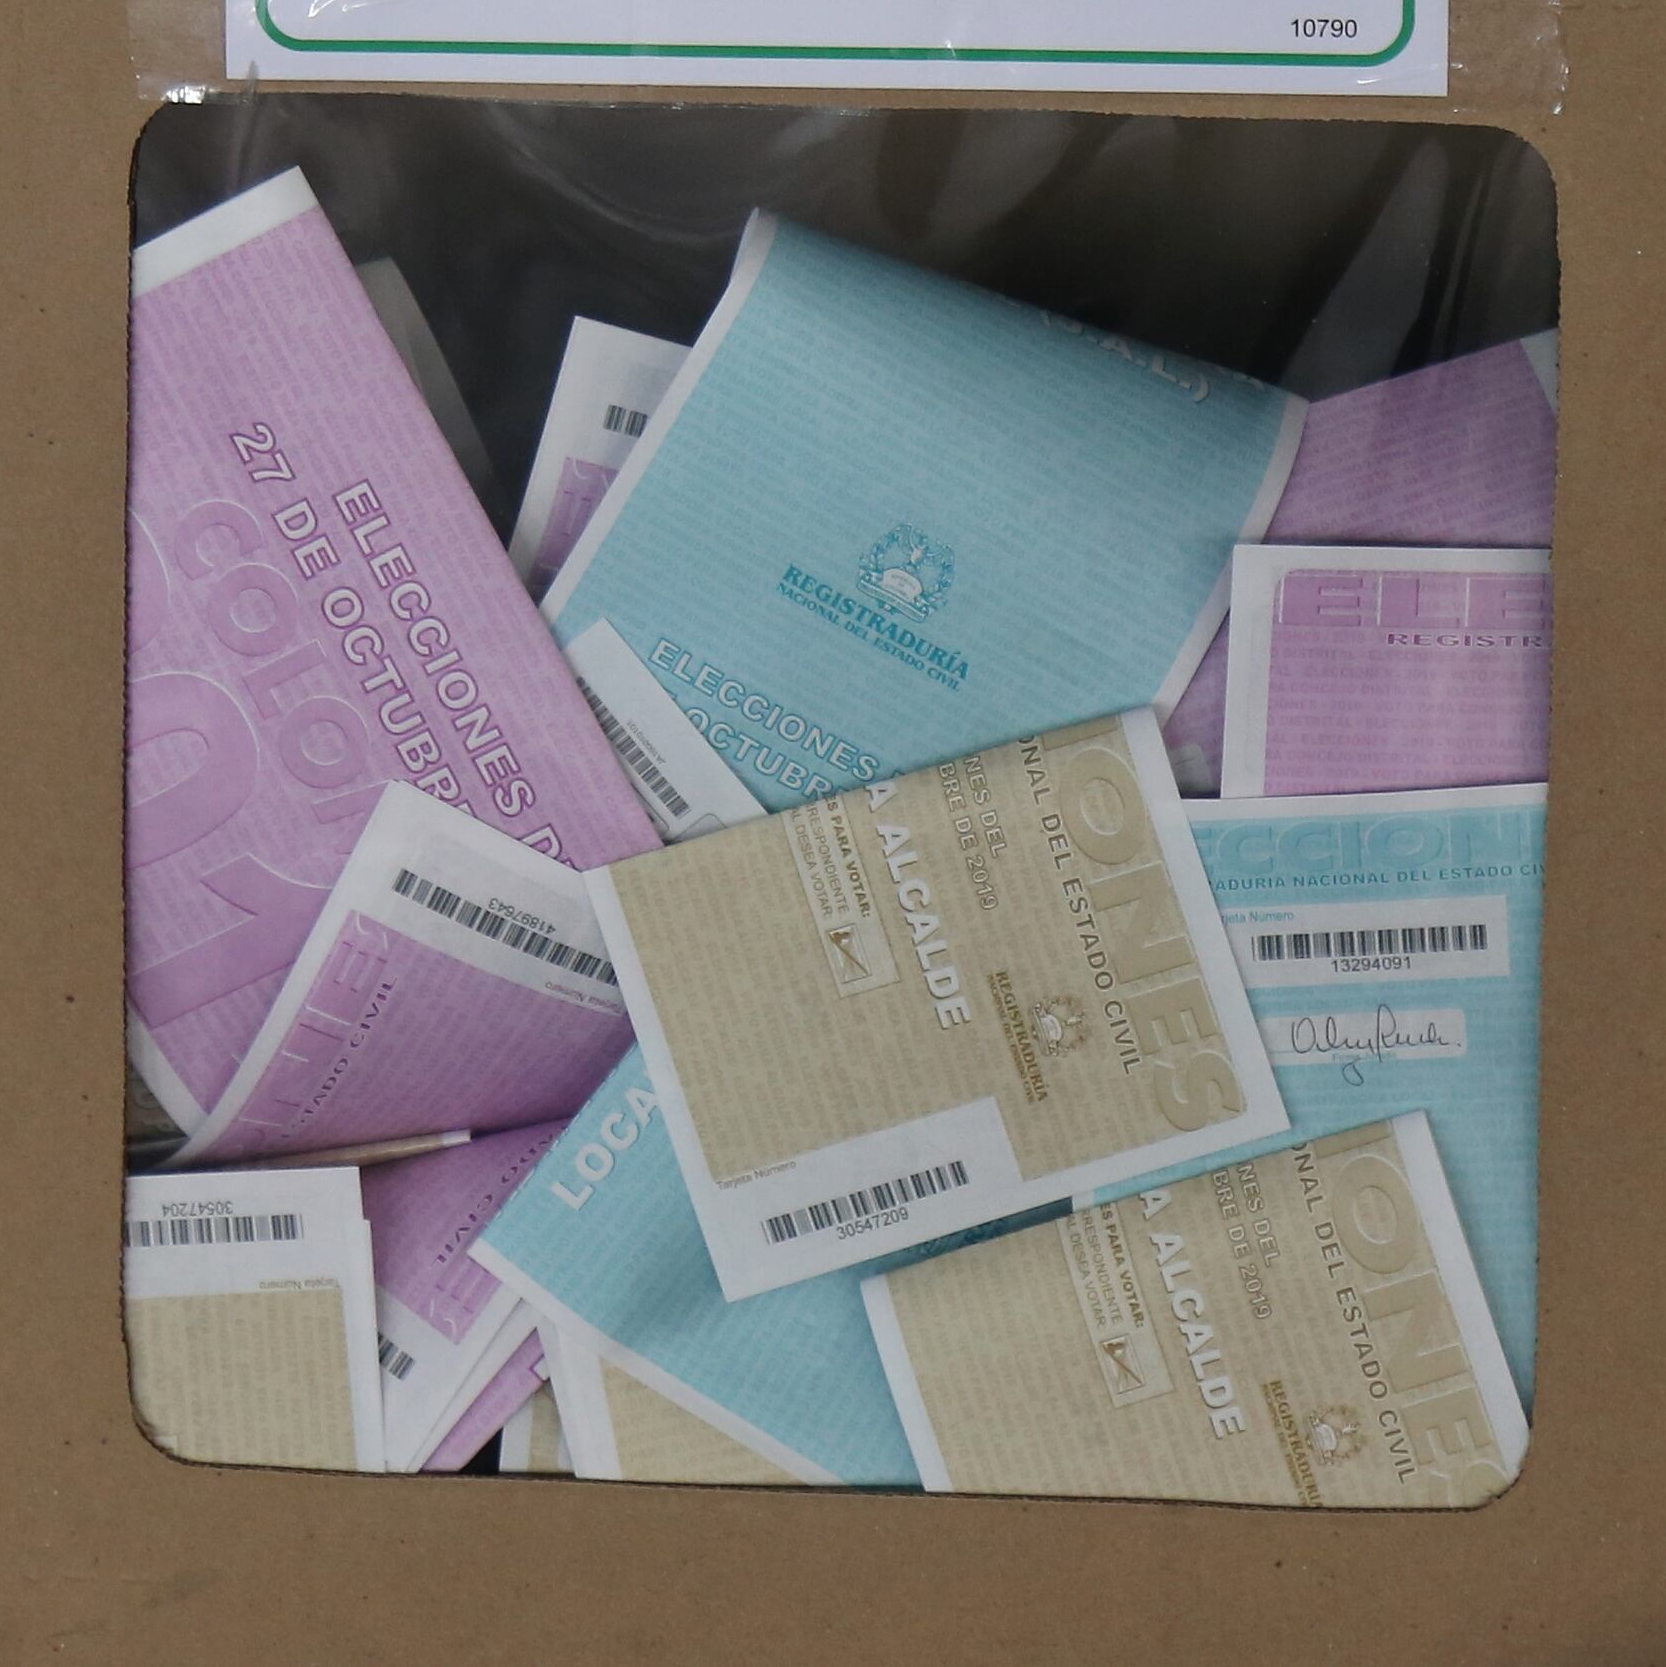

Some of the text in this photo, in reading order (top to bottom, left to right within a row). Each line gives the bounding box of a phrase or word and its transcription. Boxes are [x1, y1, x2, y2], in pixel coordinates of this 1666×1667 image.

[1289, 17, 1359, 39] 10790
[230, 422, 478, 818] 27 DE OCTUBR
[333, 478, 536, 818] ELECCIONES
[777, 583, 960, 691] NACIONAL DEL ESTADO CIVIL
[783, 563, 969, 680] REGISTRADURÍA
[1387, 633, 1543, 648] REGISTR
[648, 637, 881, 782] ELECCIONES
[686, 708, 850, 804] OCTUBR
[795, 823, 818, 871] DESEA
[810, 871, 833, 919] VOTAR
[831, 816, 853, 862] PARA
[845, 863, 871, 919] VOTAR:
[939, 762, 999, 911] BRE DE 2019
[981, 811, 1007, 858] DEL
[1208, 877, 1286, 893] ADURIA
[1293, 873, 1390, 889] NACIONAL
[1397, 869, 1431, 883] DEL
[1440, 865, 1513, 881] ESTADO
[488, 896, 557, 934] 41897643
[876, 824, 972, 1030] ALCALDE
[1041, 814, 1065, 870] DEL
[1062, 878, 1113, 991] ESTADO
[1105, 1001, 1141, 1075] CIVIL
[1331, 956, 1412, 974] 13294091
[349, 977, 398, 1048] CIVIL
[551, 1072, 658, 1211] LOCA
[162, 1201, 233, 1216] 30547204
[836, 1207, 910, 1241] 30547209
[1212, 1168, 1273, 1321] BRE DE 2019
[1254, 1218, 1281, 1268] DEL
[1083, 1284, 1107, 1329] VOTAR
[1106, 1222, 1127, 1270] PARA
[1119, 1269, 1145, 1329] VOTAR:
[1150, 1233, 1246, 1440] ALCALDE
[1314, 1221, 1344, 1279] DEL
[1336, 1286, 1389, 1400] ESTADO
[1379, 1409, 1418, 1485] CIVIL
